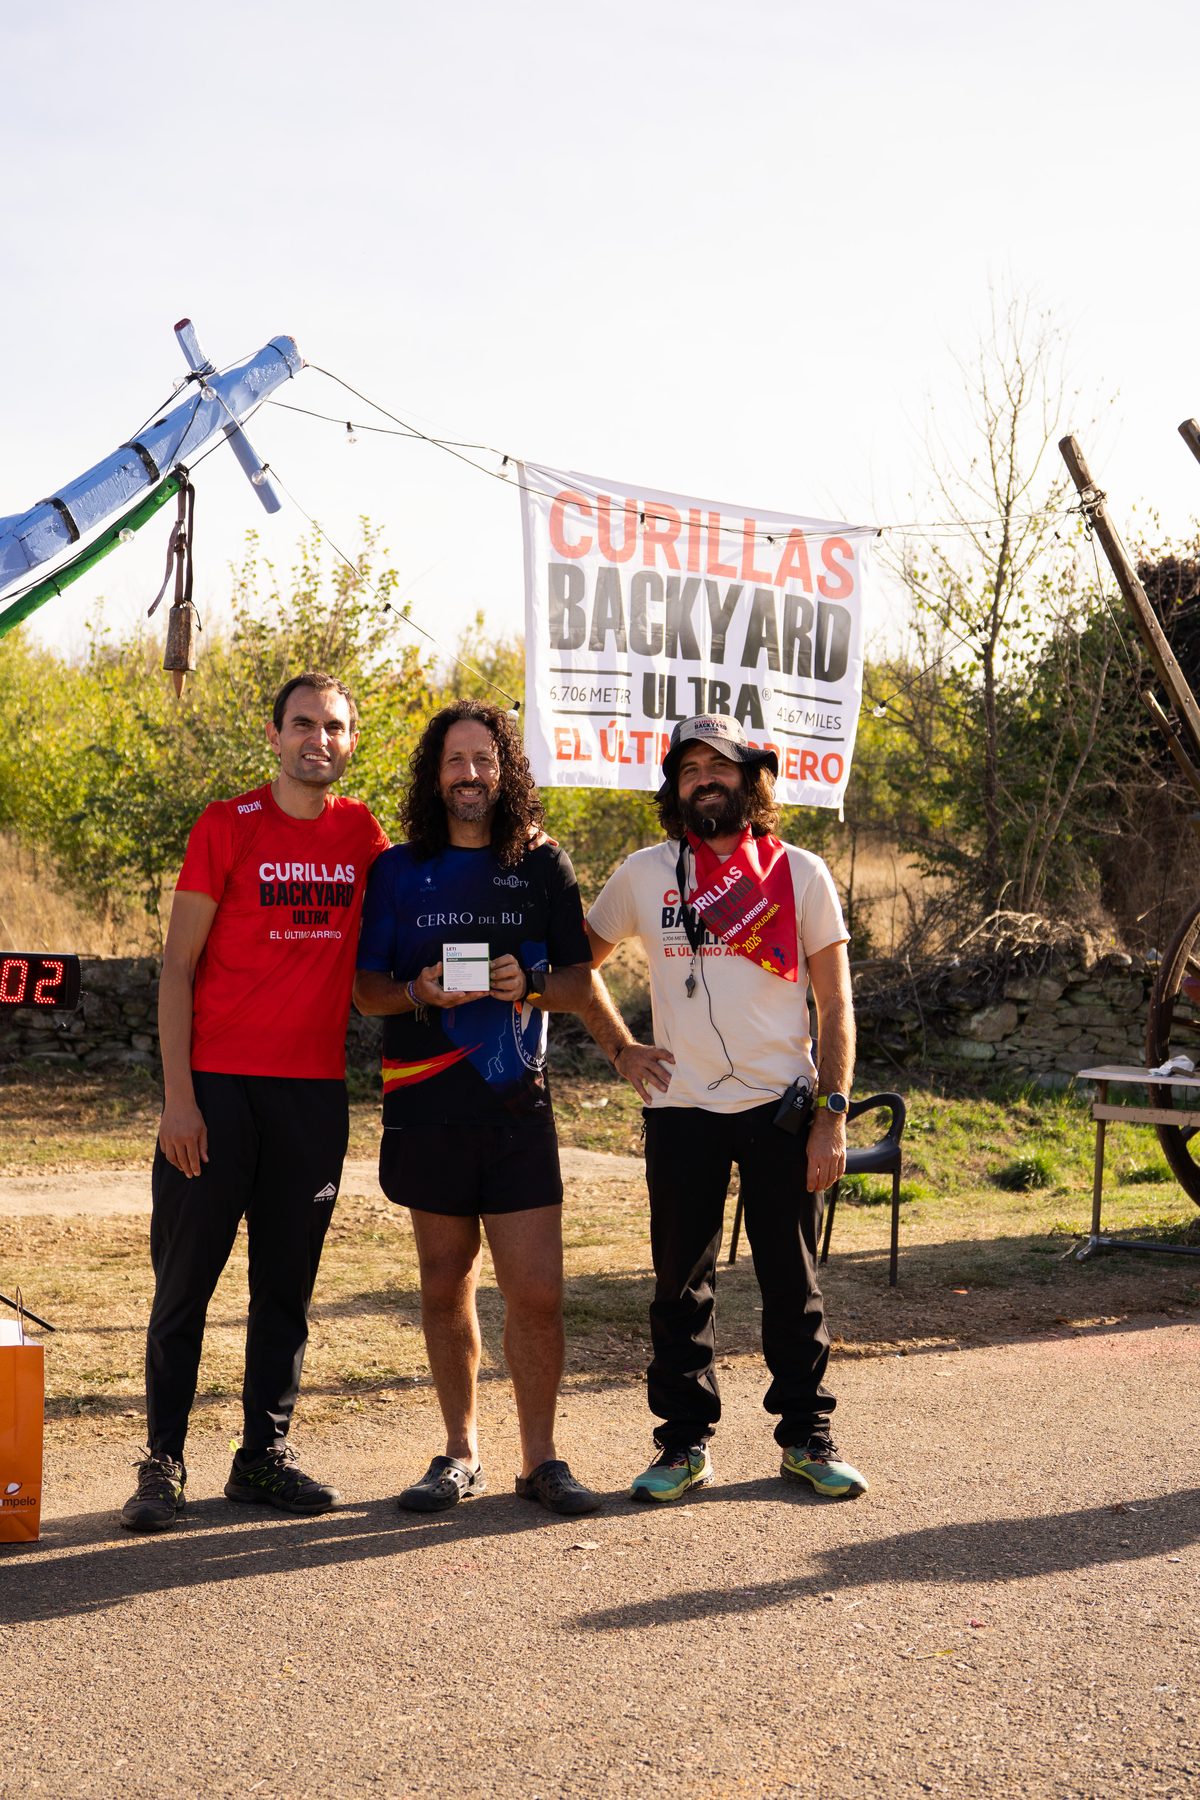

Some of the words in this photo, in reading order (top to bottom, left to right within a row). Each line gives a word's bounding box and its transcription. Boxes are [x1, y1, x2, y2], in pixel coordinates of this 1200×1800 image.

[549, 490, 855, 600] CURILLAS
[548, 562, 852, 683] BACKYARD
[550, 686, 587, 702] 6.706
[804, 711, 842, 730] MILES
[554, 727, 592, 760] EL
[599, 720, 671, 766] ÚLTI
[259, 862, 355, 882] CURILLAS
[260, 882, 355, 907] BACKYARD
[292, 910, 329, 925] ULTRA
[416, 912, 473, 928] CERRO
[478, 916, 496, 925] DEL
[722, 923, 742, 943] LTIMO
[741, 897, 769, 926] ARRIERO
[751, 903, 780, 933] SOLIDARIA
[270, 931, 282, 939] EL
[742, 933, 762, 954] 2026
[664, 948, 676, 957] EL
[678, 944, 722, 957] ÚLIMO
[0, 959, 64, 1004] 02
[0, 1496, 36, 1508] mpelo
